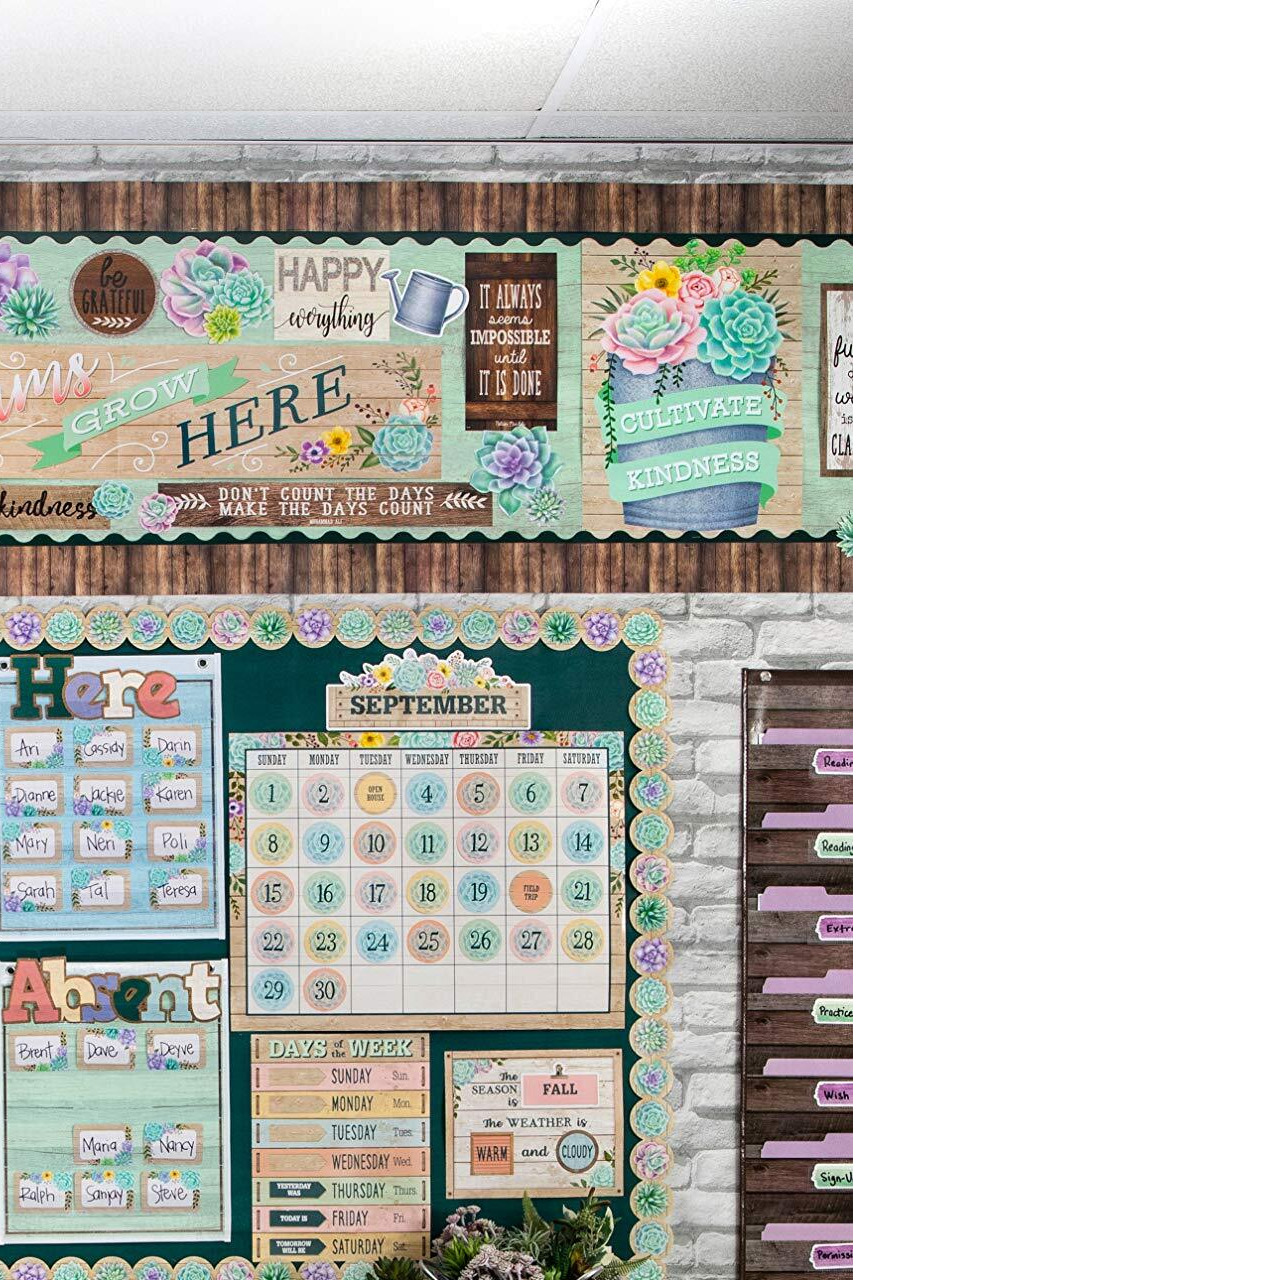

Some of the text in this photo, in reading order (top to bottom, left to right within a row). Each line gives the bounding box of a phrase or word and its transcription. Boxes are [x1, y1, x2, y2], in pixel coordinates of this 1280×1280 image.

[100, 256, 127, 288] be
[278, 257, 384, 293] HAPPY
[82, 290, 147, 315] GRATEFUL
[480, 283, 542, 309] IT ALWAYS
[275, 295, 389, 337] everything
[488, 315, 533, 325] seems
[470, 329, 551, 345] IMPOSSIBLE
[494, 348, 527, 364] until
[479, 370, 542, 396] IT IS DONE
[71, 368, 198, 435] GROW
[176, 364, 350, 469] HERE
[620, 394, 763, 435] CULTIVATE
[626, 451, 760, 492] KINDNESS
[218, 486, 434, 501] DON'T COUNT THE DAYS
[219, 501, 434, 516] MAKE THE DAYS COUNT
[10, 654, 181, 719] Here
[350, 694, 507, 715] SEPTEMBER
[15, 737, 191, 757] Ari Cassidy Darin
[258, 753, 601, 765] SUNDAY MONDAY TUESDAY WEDNESDAY THURSDAY FRIDAY SATURDAY
[12, 786, 193, 803] Dianne Jackie Karen
[421, 785, 433, 803] 4
[16, 832, 188, 853] Mary Poli
[523, 833, 539, 852] 13
[17, 882, 197, 899] Sarah Tal Teresa
[419, 882, 436, 902] 18
[367, 933, 389, 952] 24
[470, 930, 491, 950] 26
[2, 956, 222, 1024] Absent
[315, 981, 335, 1001] 30
[16, 1040, 119, 1059] Brent Dave
[269, 1039, 413, 1059] DAYS of the WEEK
[331, 1068, 410, 1084] SUNDAY Sun.
[499, 1072, 518, 1081] The
[472, 1085, 517, 1095] SEASON
[543, 1083, 578, 1095] FALL
[824, 1090, 849, 1100] Wish
[508, 1098, 518, 1107] is
[483, 1117, 588, 1128] The WEATHER is
[332, 1125, 377, 1141] TUESDAY
[159, 1136, 195, 1156] Nancy
[476, 1145, 593, 1161] WARM and CLOUDY
[332, 1154, 390, 1170] WEDNESDAY
[20, 1184, 188, 1203] Ralph Steve
[332, 1182, 386, 1199] THURSDAY
[332, 1210, 369, 1227] FRIDAY
